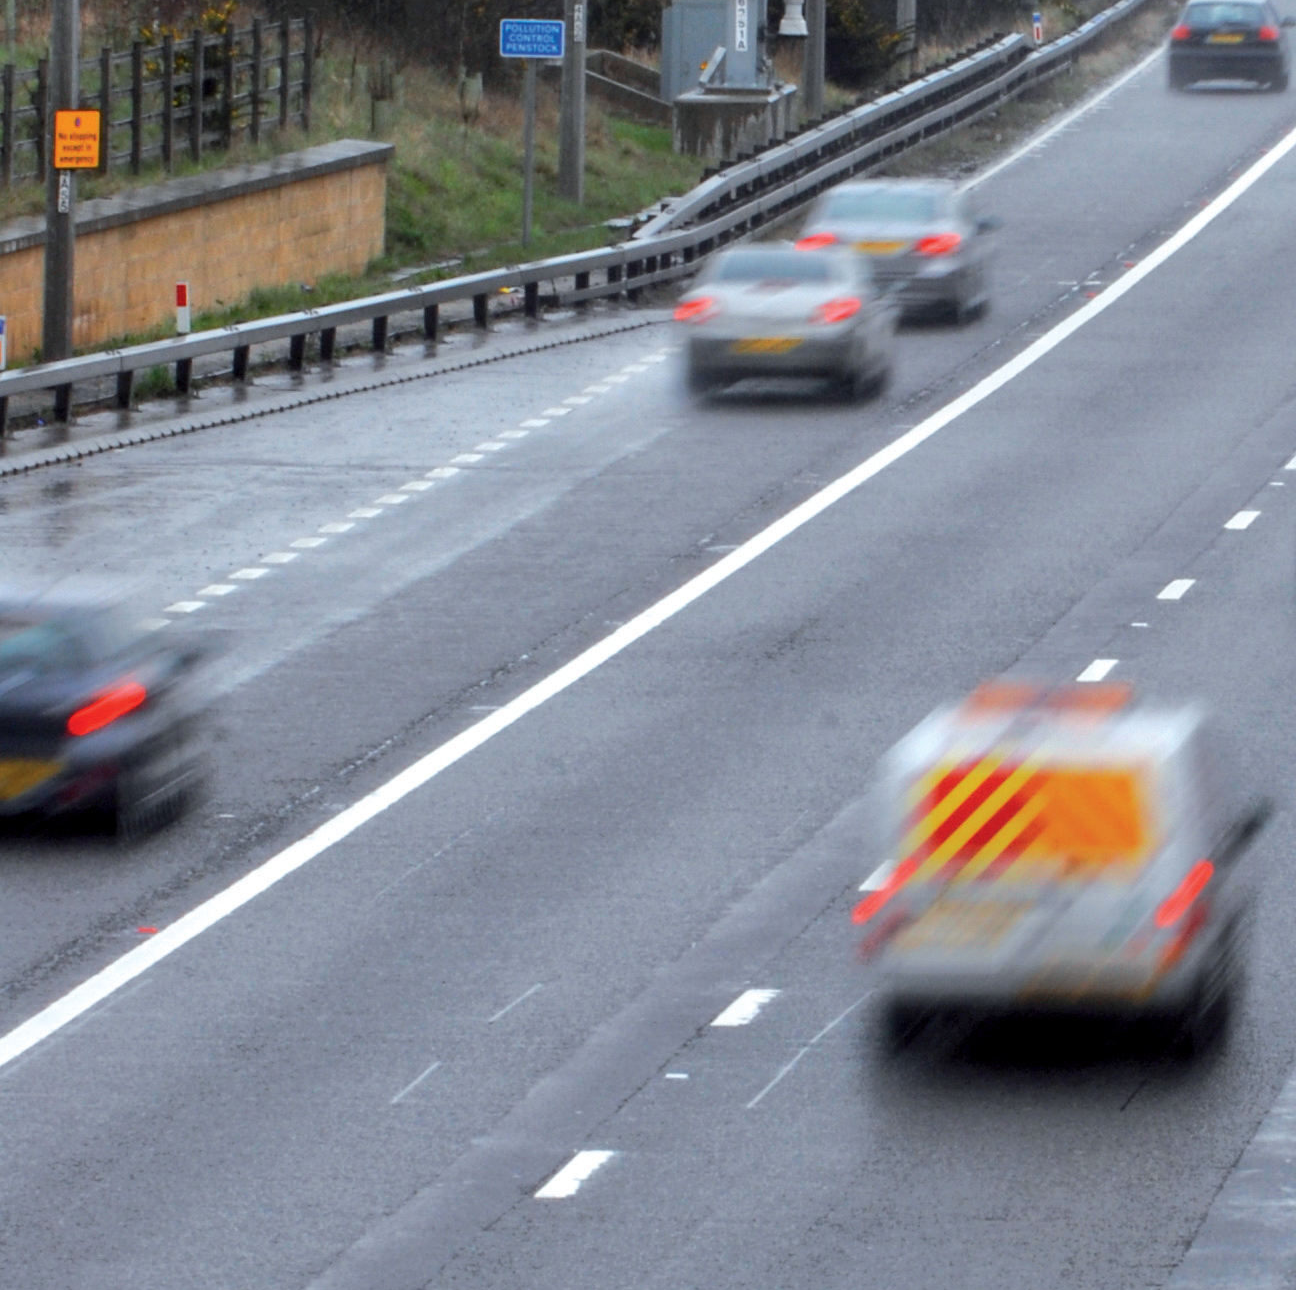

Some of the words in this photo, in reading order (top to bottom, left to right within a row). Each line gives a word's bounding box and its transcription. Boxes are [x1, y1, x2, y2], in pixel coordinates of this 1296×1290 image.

[505, 23, 560, 33] POLLUTION
[509, 33, 556, 43] CONTROL
[505, 43, 559, 53] PENSTOCK
